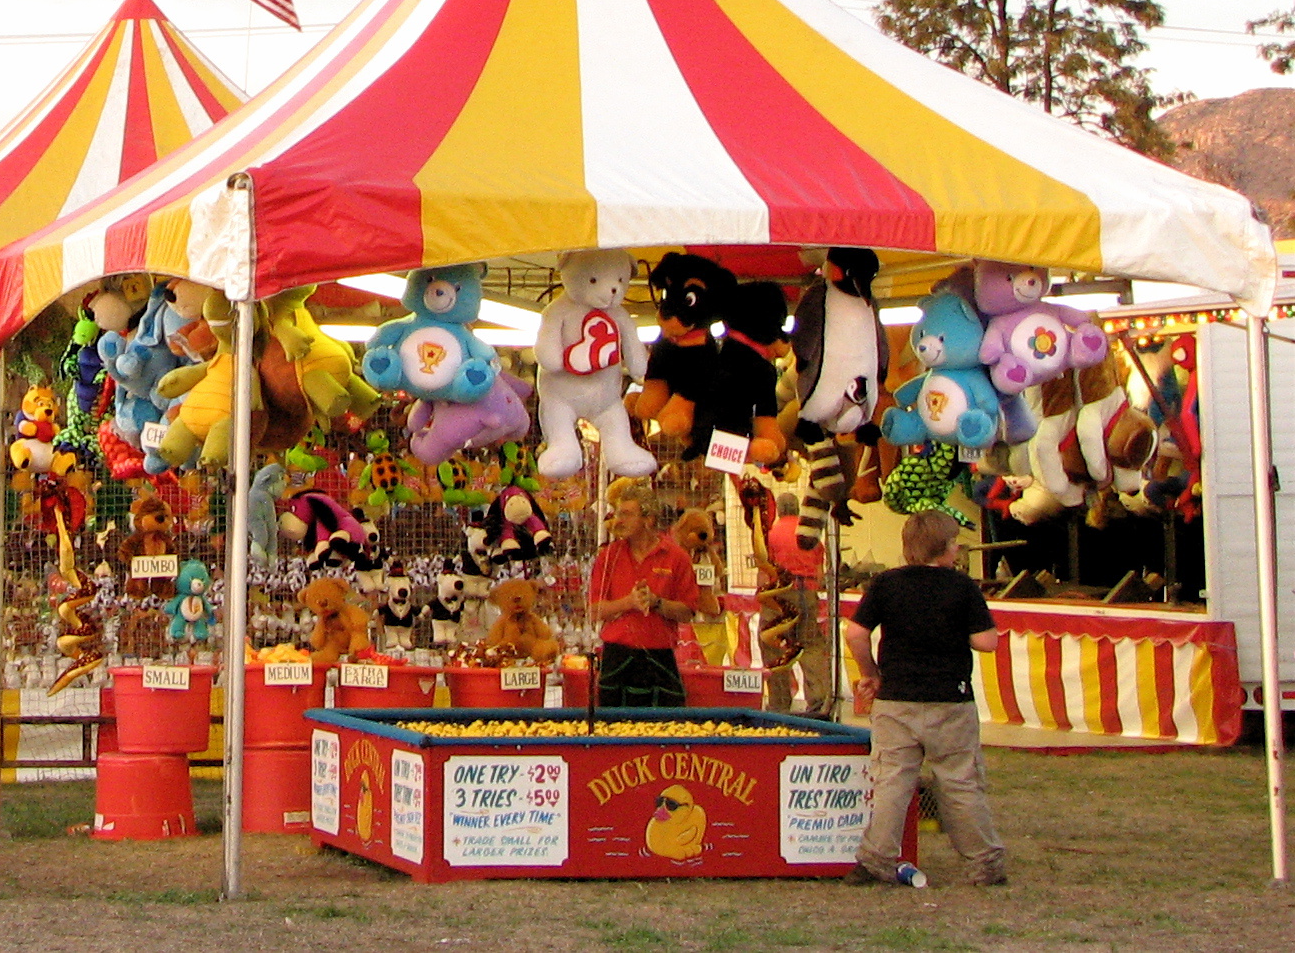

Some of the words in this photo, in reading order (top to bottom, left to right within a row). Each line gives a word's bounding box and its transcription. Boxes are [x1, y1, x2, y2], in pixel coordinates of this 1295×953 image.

[710, 442, 743, 464] CHOICE
[134, 559, 176, 574] JUMBO
[145, 670, 187, 687] SMALL
[267, 665, 310, 682] MEDIUM
[344, 666, 385, 679] EXTRA
[344, 675, 385, 686] LARGE
[504, 671, 538, 686] LARGE
[726, 673, 761, 689] SMALL
[453, 765, 487, 785] ONE
[489, 764, 520, 785] TRY
[587, 755, 656, 806] DUCK
[659, 752, 757, 806] CENTRAL
[789, 764, 814, 784] UN
[816, 763, 852, 784] TIRO
[455, 787, 466, 808] 3
[471, 788, 518, 808] TRIES
[787, 789, 823, 810] TRES
[823, 789, 863, 810] TIROS
[493, 811, 526, 828] EVERY
[837, 812, 864, 828] CADA
[463, 836, 496, 846] TRADE
[501, 836, 532, 846] SMALL
[537, 836, 559, 846] FOR
